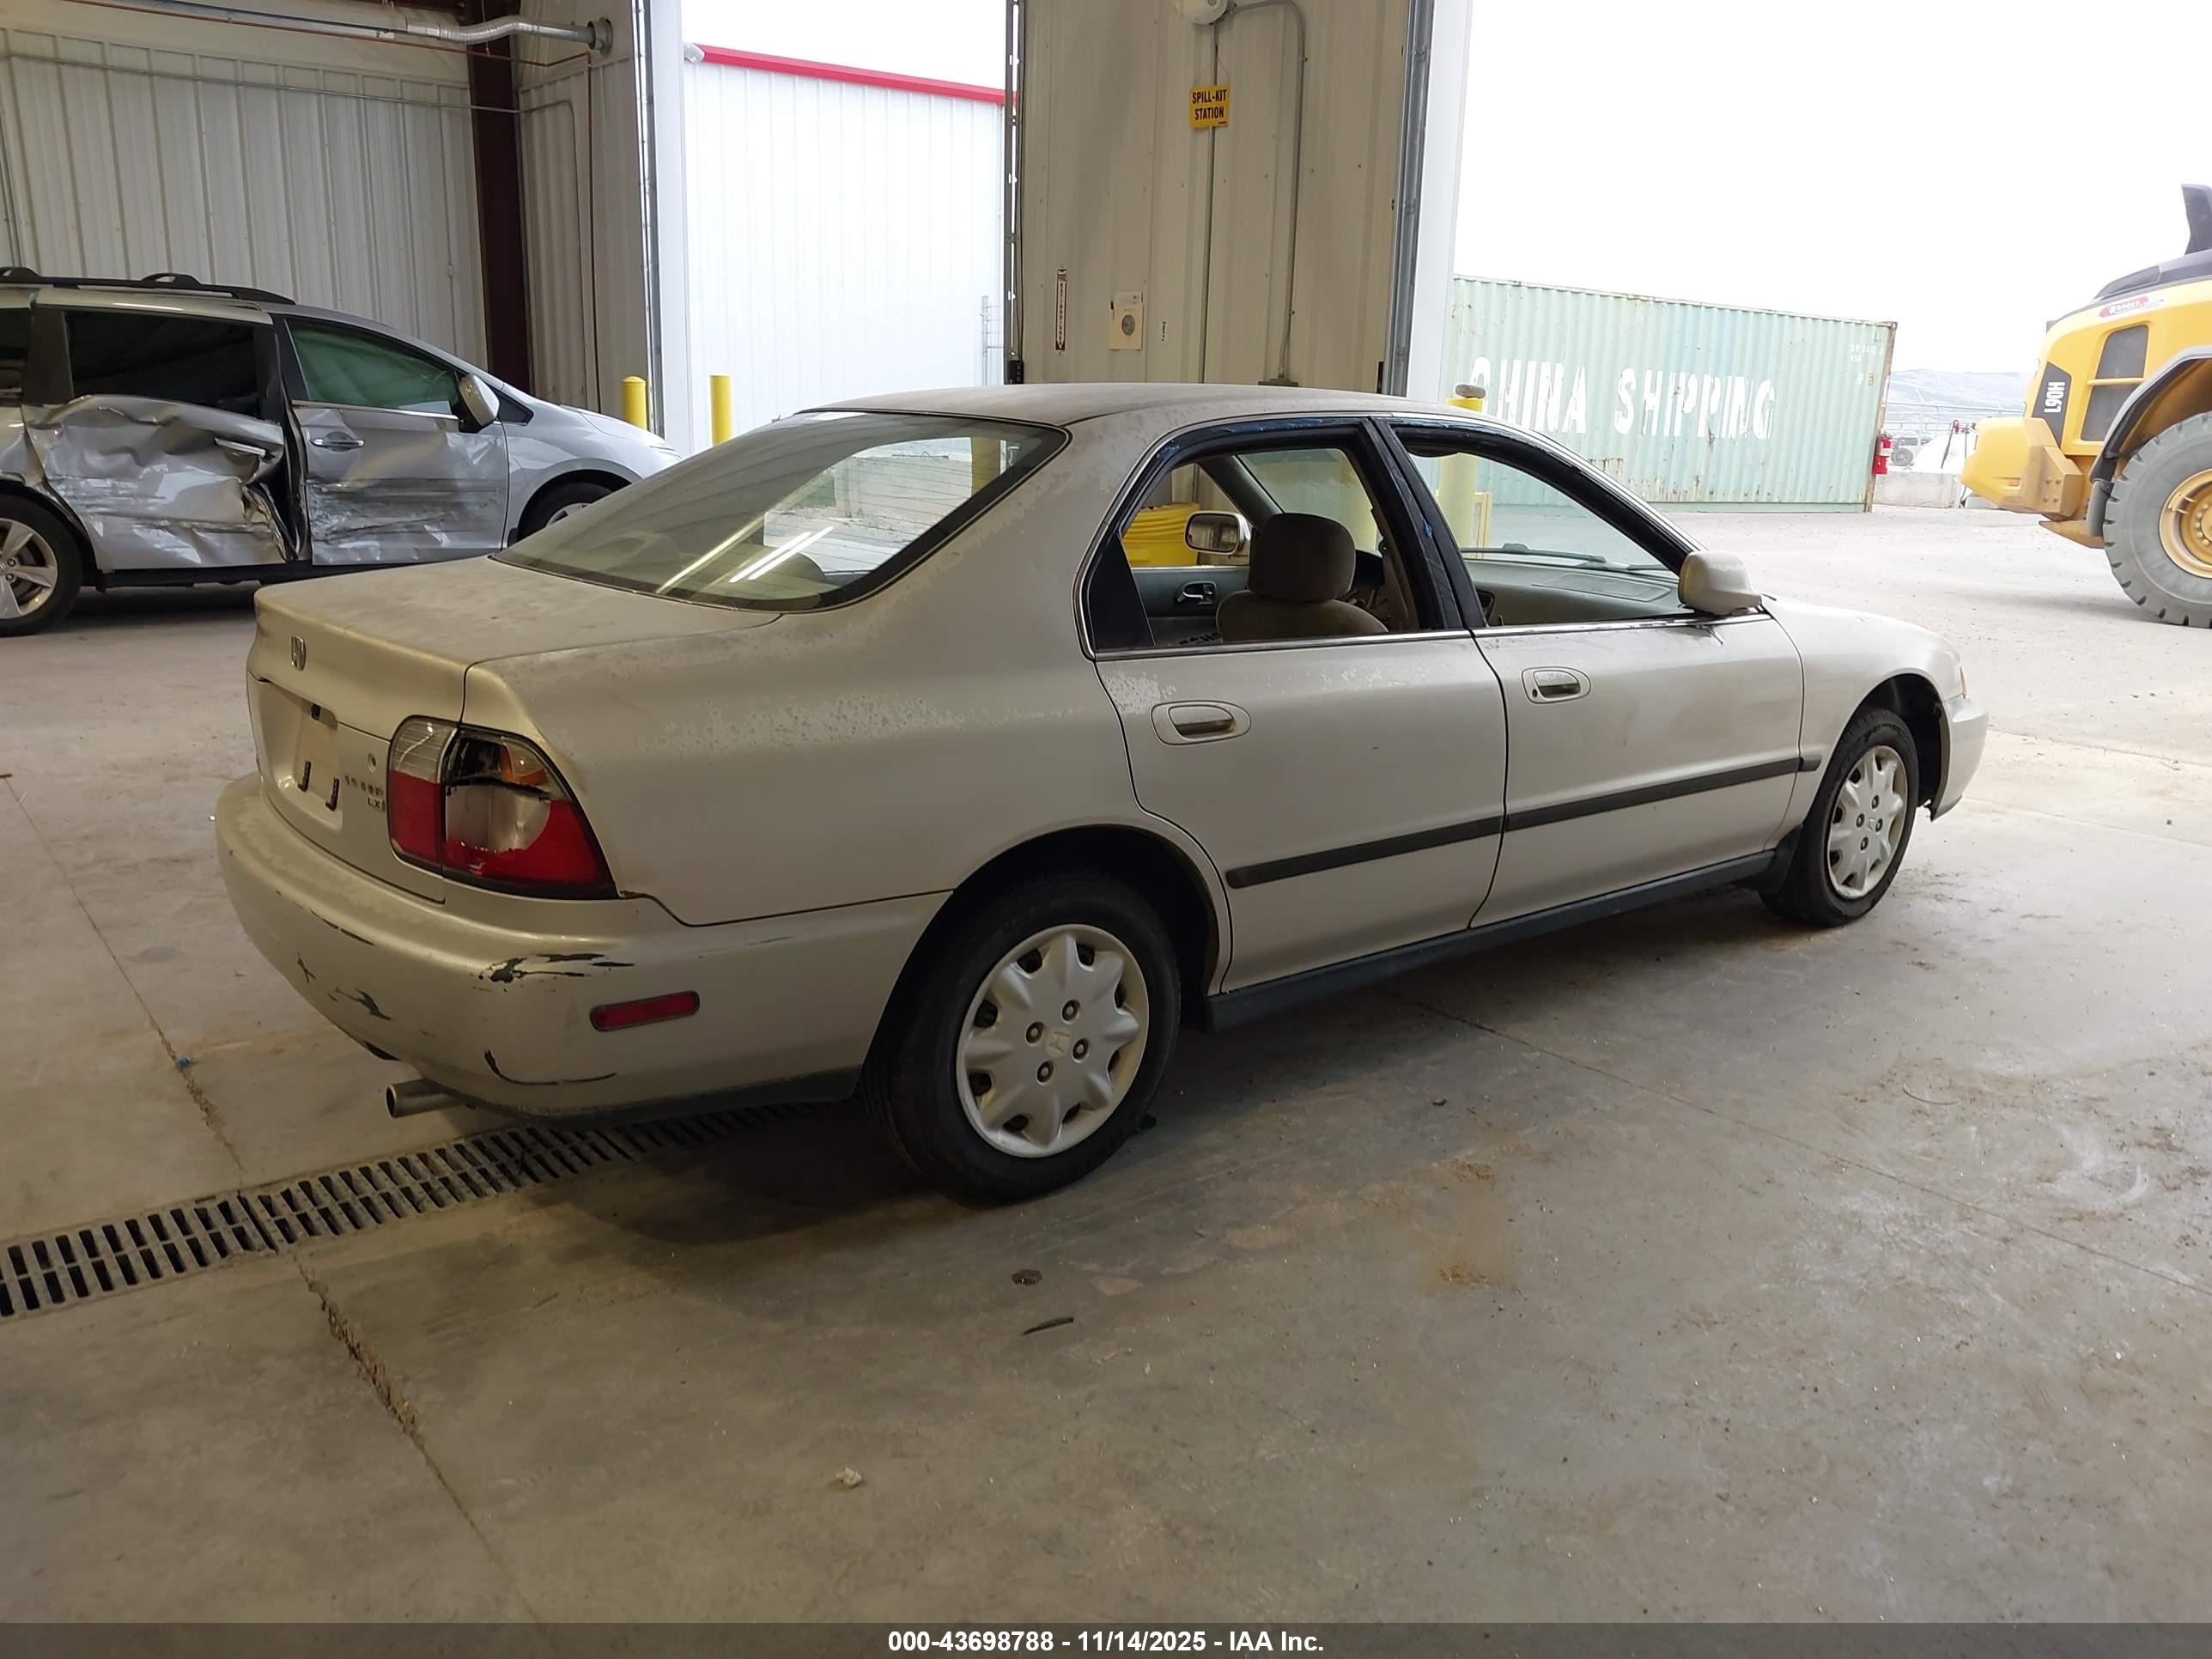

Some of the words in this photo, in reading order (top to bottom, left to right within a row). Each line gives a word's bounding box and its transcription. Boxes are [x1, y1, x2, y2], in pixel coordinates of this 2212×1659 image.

[1192, 89, 1228, 104] SPILL-KIT
[1194, 106, 1224, 120] STATION
[1614, 368, 1776, 440] SHIPPING
[2044, 381, 2066, 413] L90H
